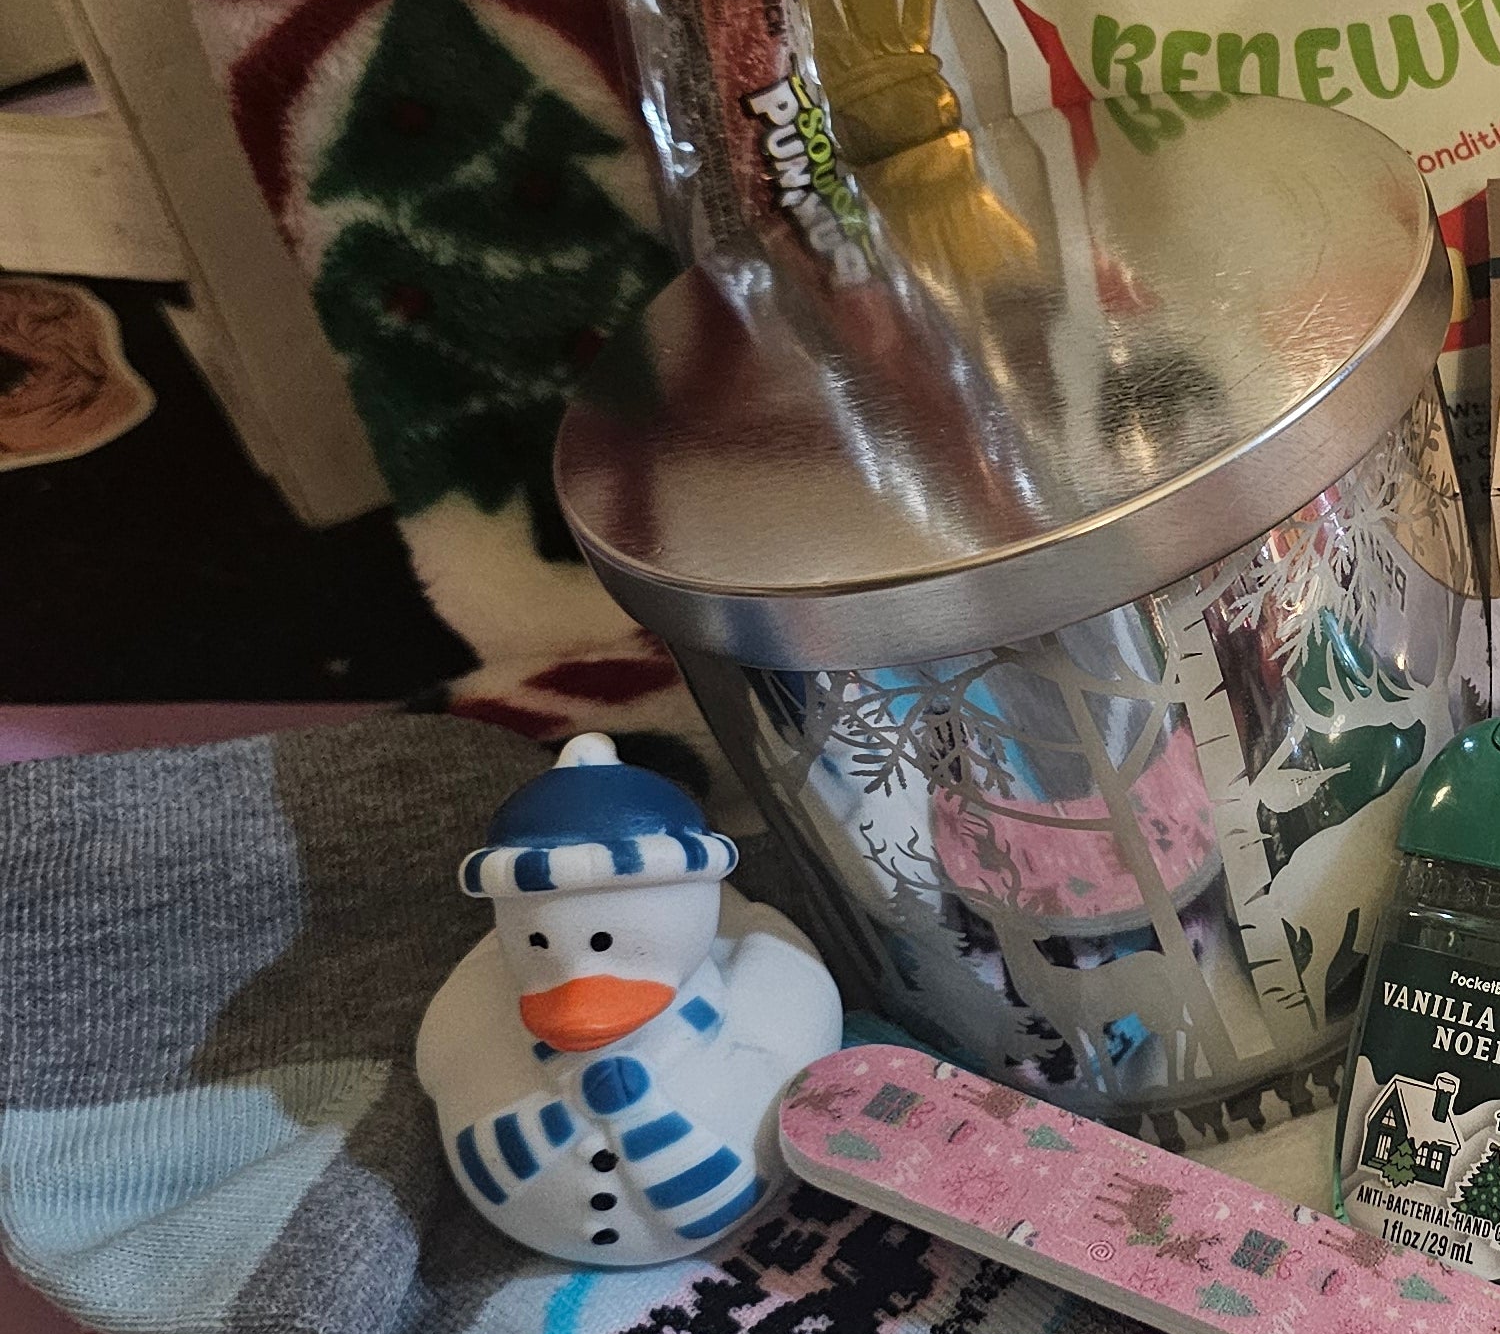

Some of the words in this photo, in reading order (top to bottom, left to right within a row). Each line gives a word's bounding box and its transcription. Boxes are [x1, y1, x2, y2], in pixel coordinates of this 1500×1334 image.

[1381, 981, 1497, 1035] VANILLA
[1356, 1184, 1451, 1229] ANTI-BACTERIAL
[1454, 1212, 1492, 1239] HAND
[1450, 1241, 1474, 1265] mL
